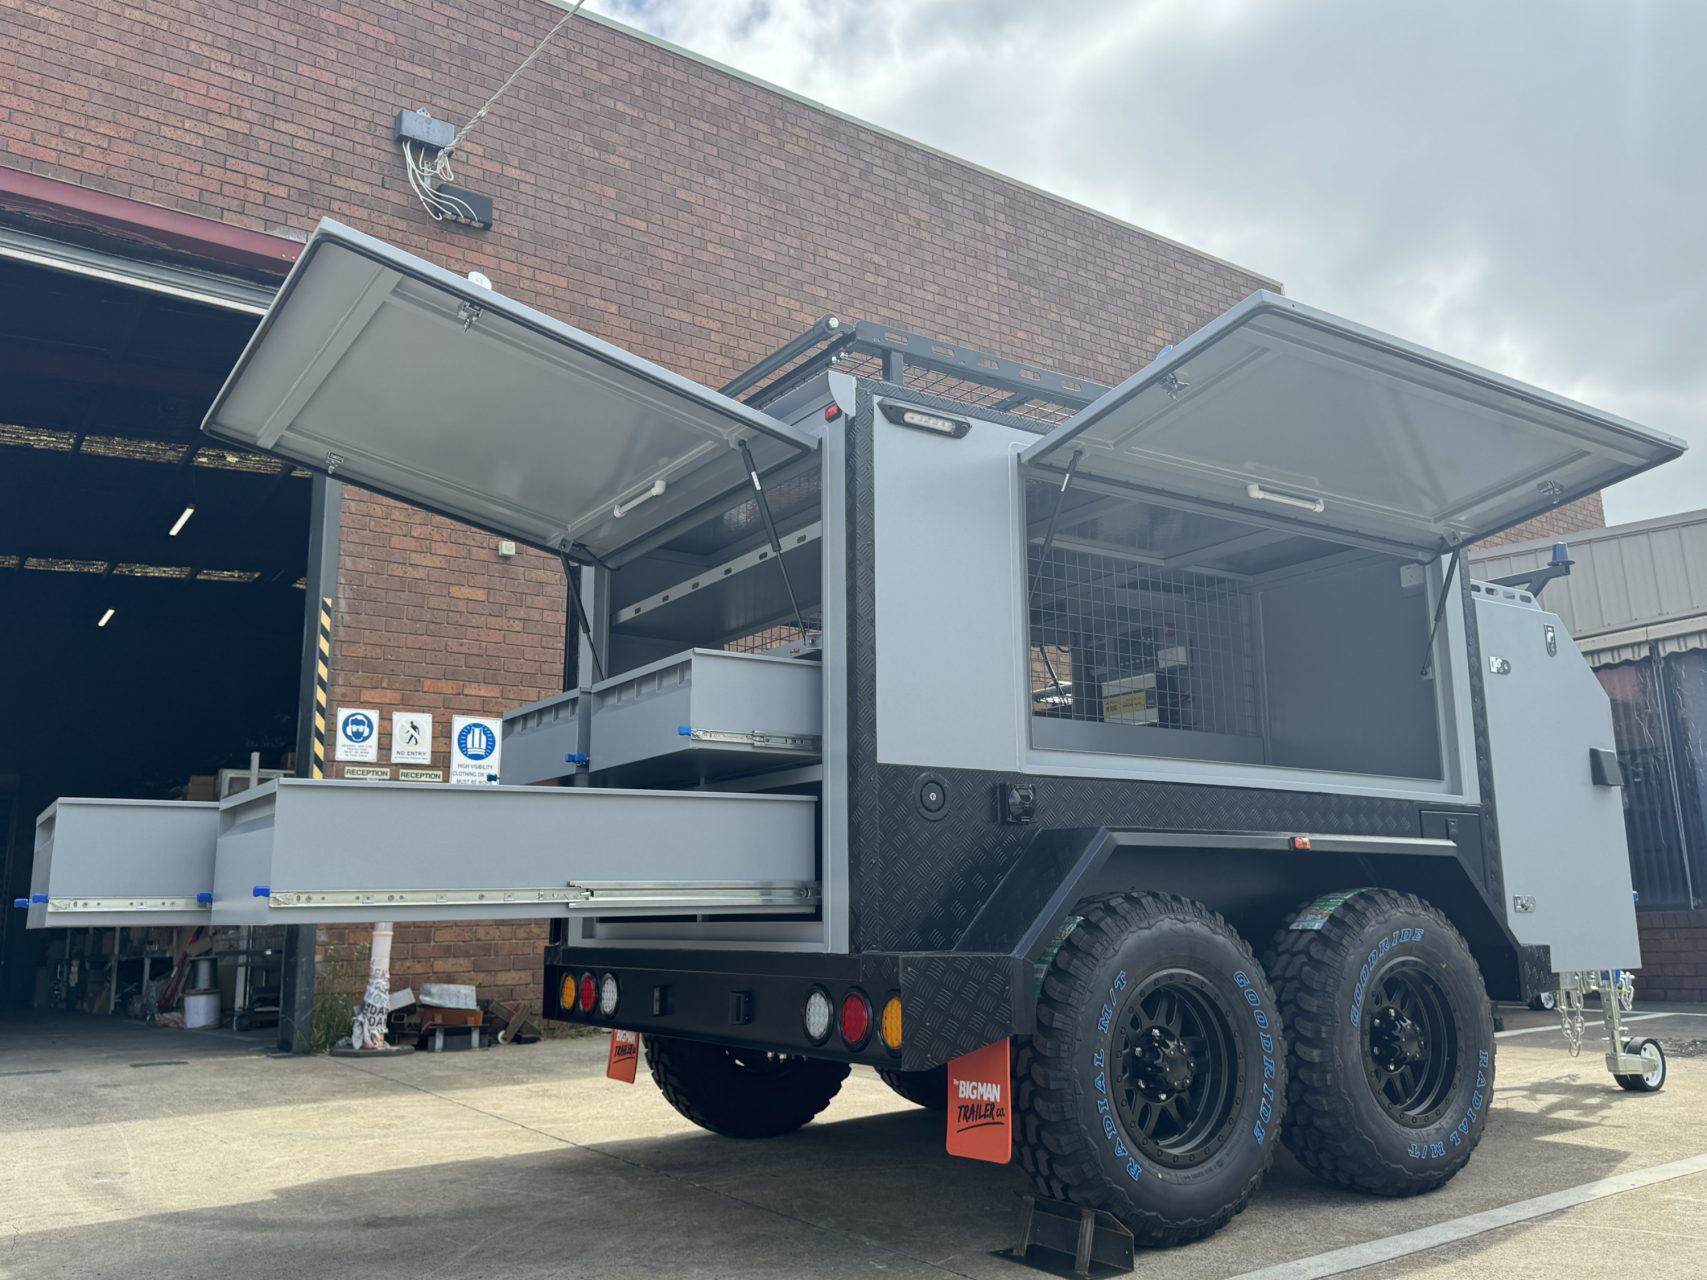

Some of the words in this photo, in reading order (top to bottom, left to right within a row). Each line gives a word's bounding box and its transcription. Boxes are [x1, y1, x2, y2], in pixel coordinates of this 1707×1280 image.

[346, 768, 389, 777] RECEPTION
[400, 772, 441, 780] RECEPTION
[1098, 970, 1128, 1034] M/T
[1350, 927, 1424, 1027] GOODRIDE
[1233, 969, 1276, 1144] GOODRIDE
[957, 1103, 995, 1123] TRAILER
[1093, 1048, 1143, 1182] RADIAL
[1450, 1049, 1489, 1146] RADIAL
[1408, 1141, 1446, 1159] M/T
